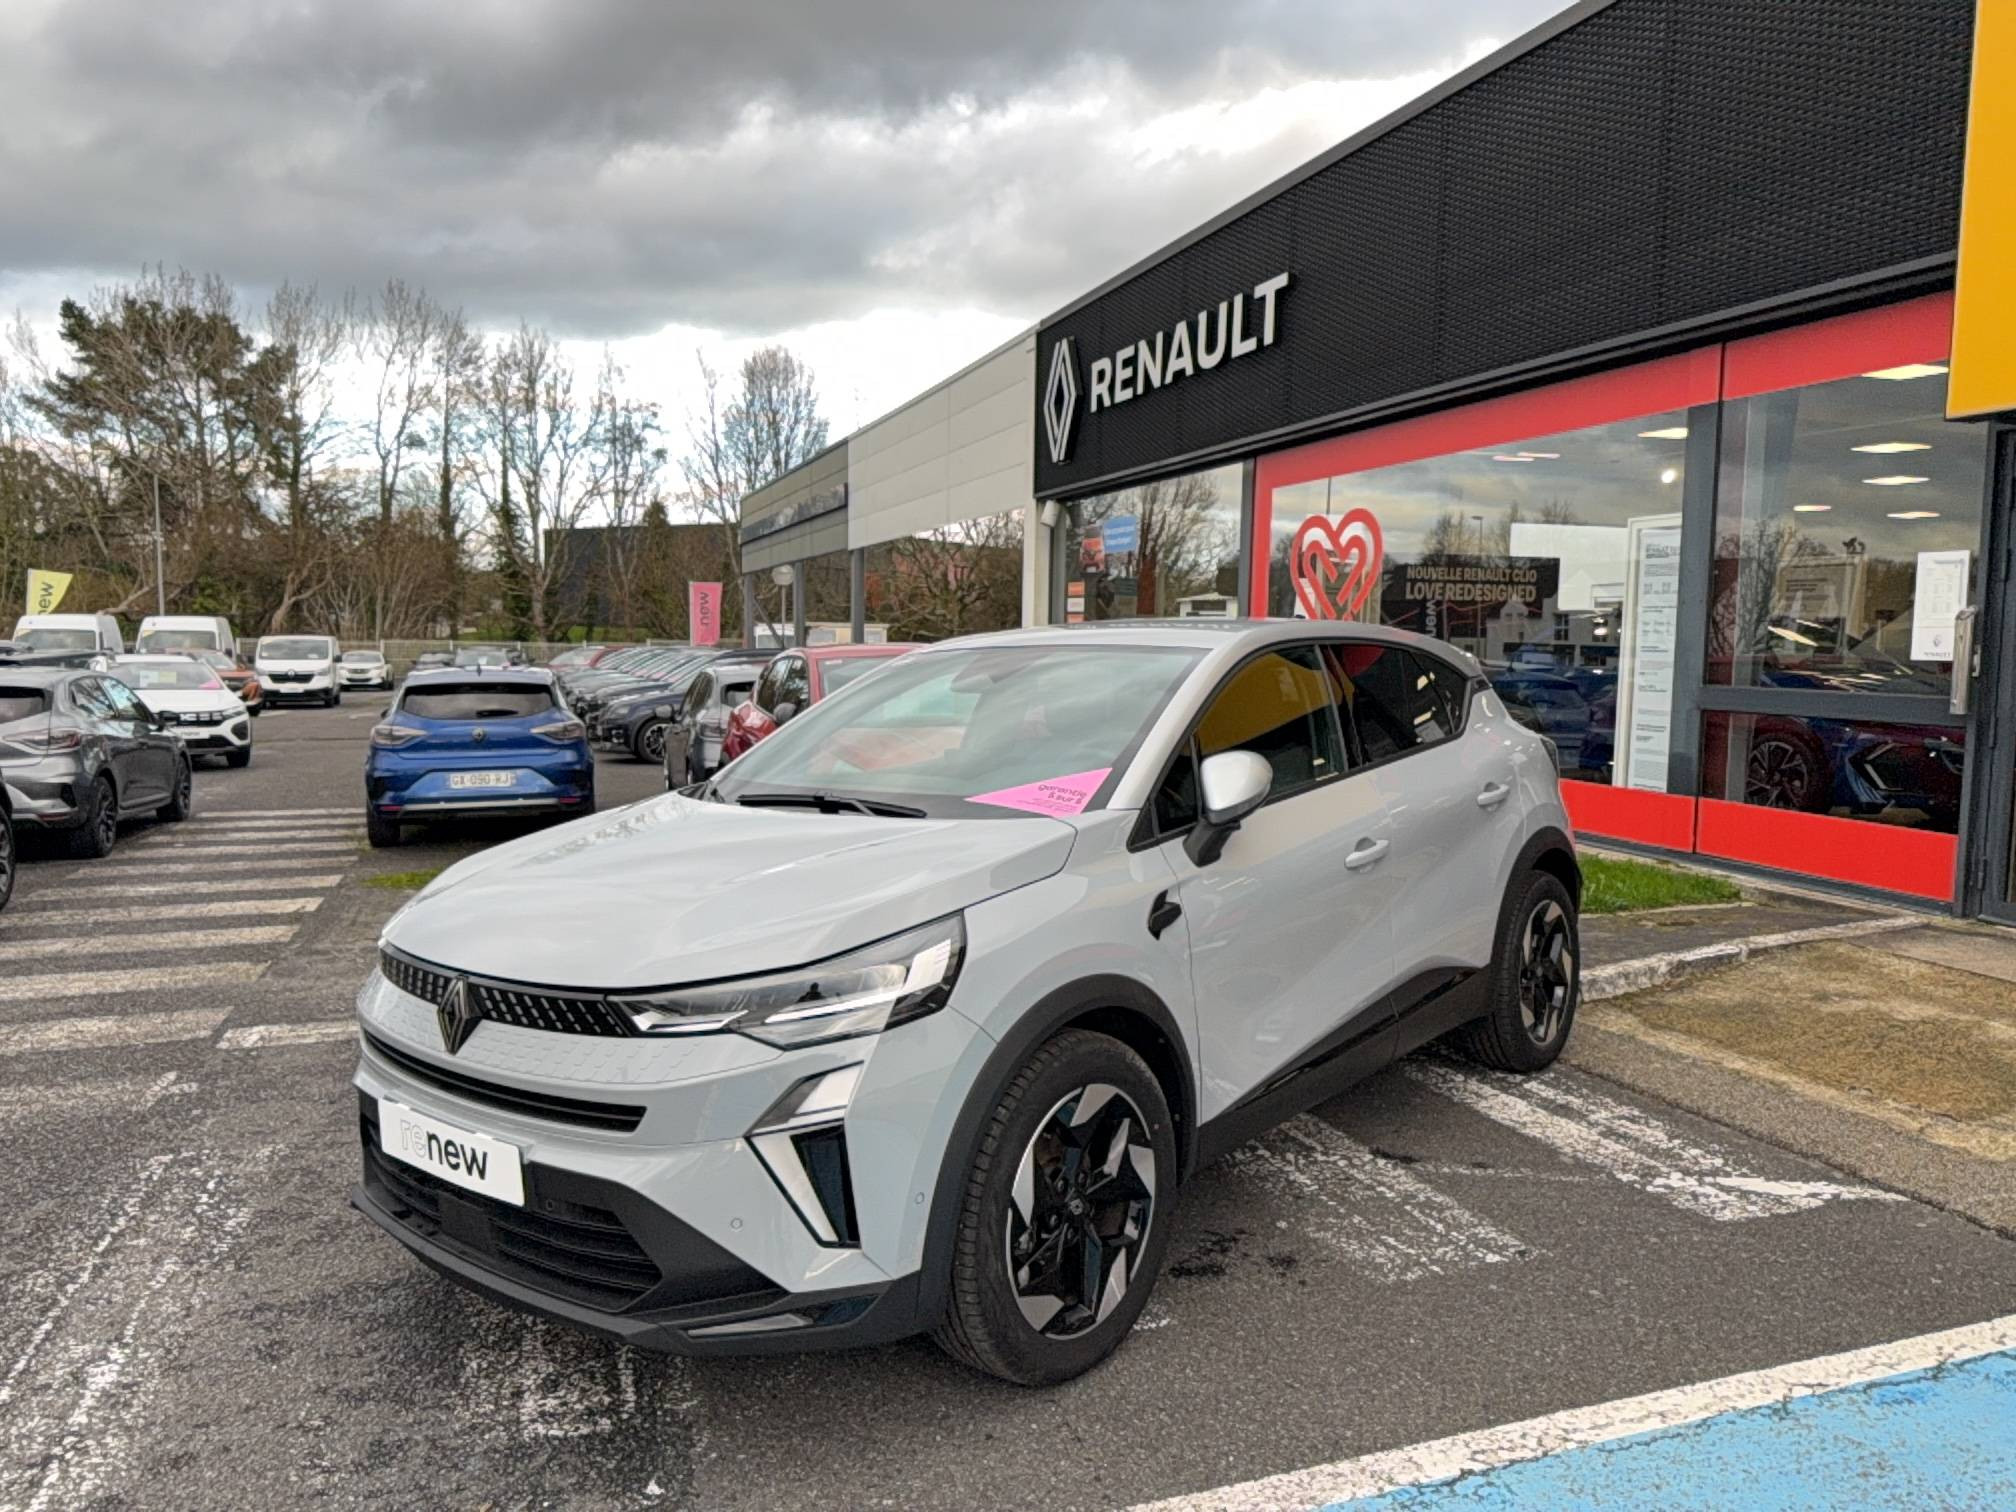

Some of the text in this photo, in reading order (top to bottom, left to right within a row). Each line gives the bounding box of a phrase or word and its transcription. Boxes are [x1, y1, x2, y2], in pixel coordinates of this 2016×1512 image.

[1090, 271, 1289, 413] RENAULT
[1405, 581, 1537, 602] LOVE REDESIGNED
[1406, 565, 1537, 582] NOUVELLE RENAULT CLIO
[400, 1119, 488, 1180] renew
